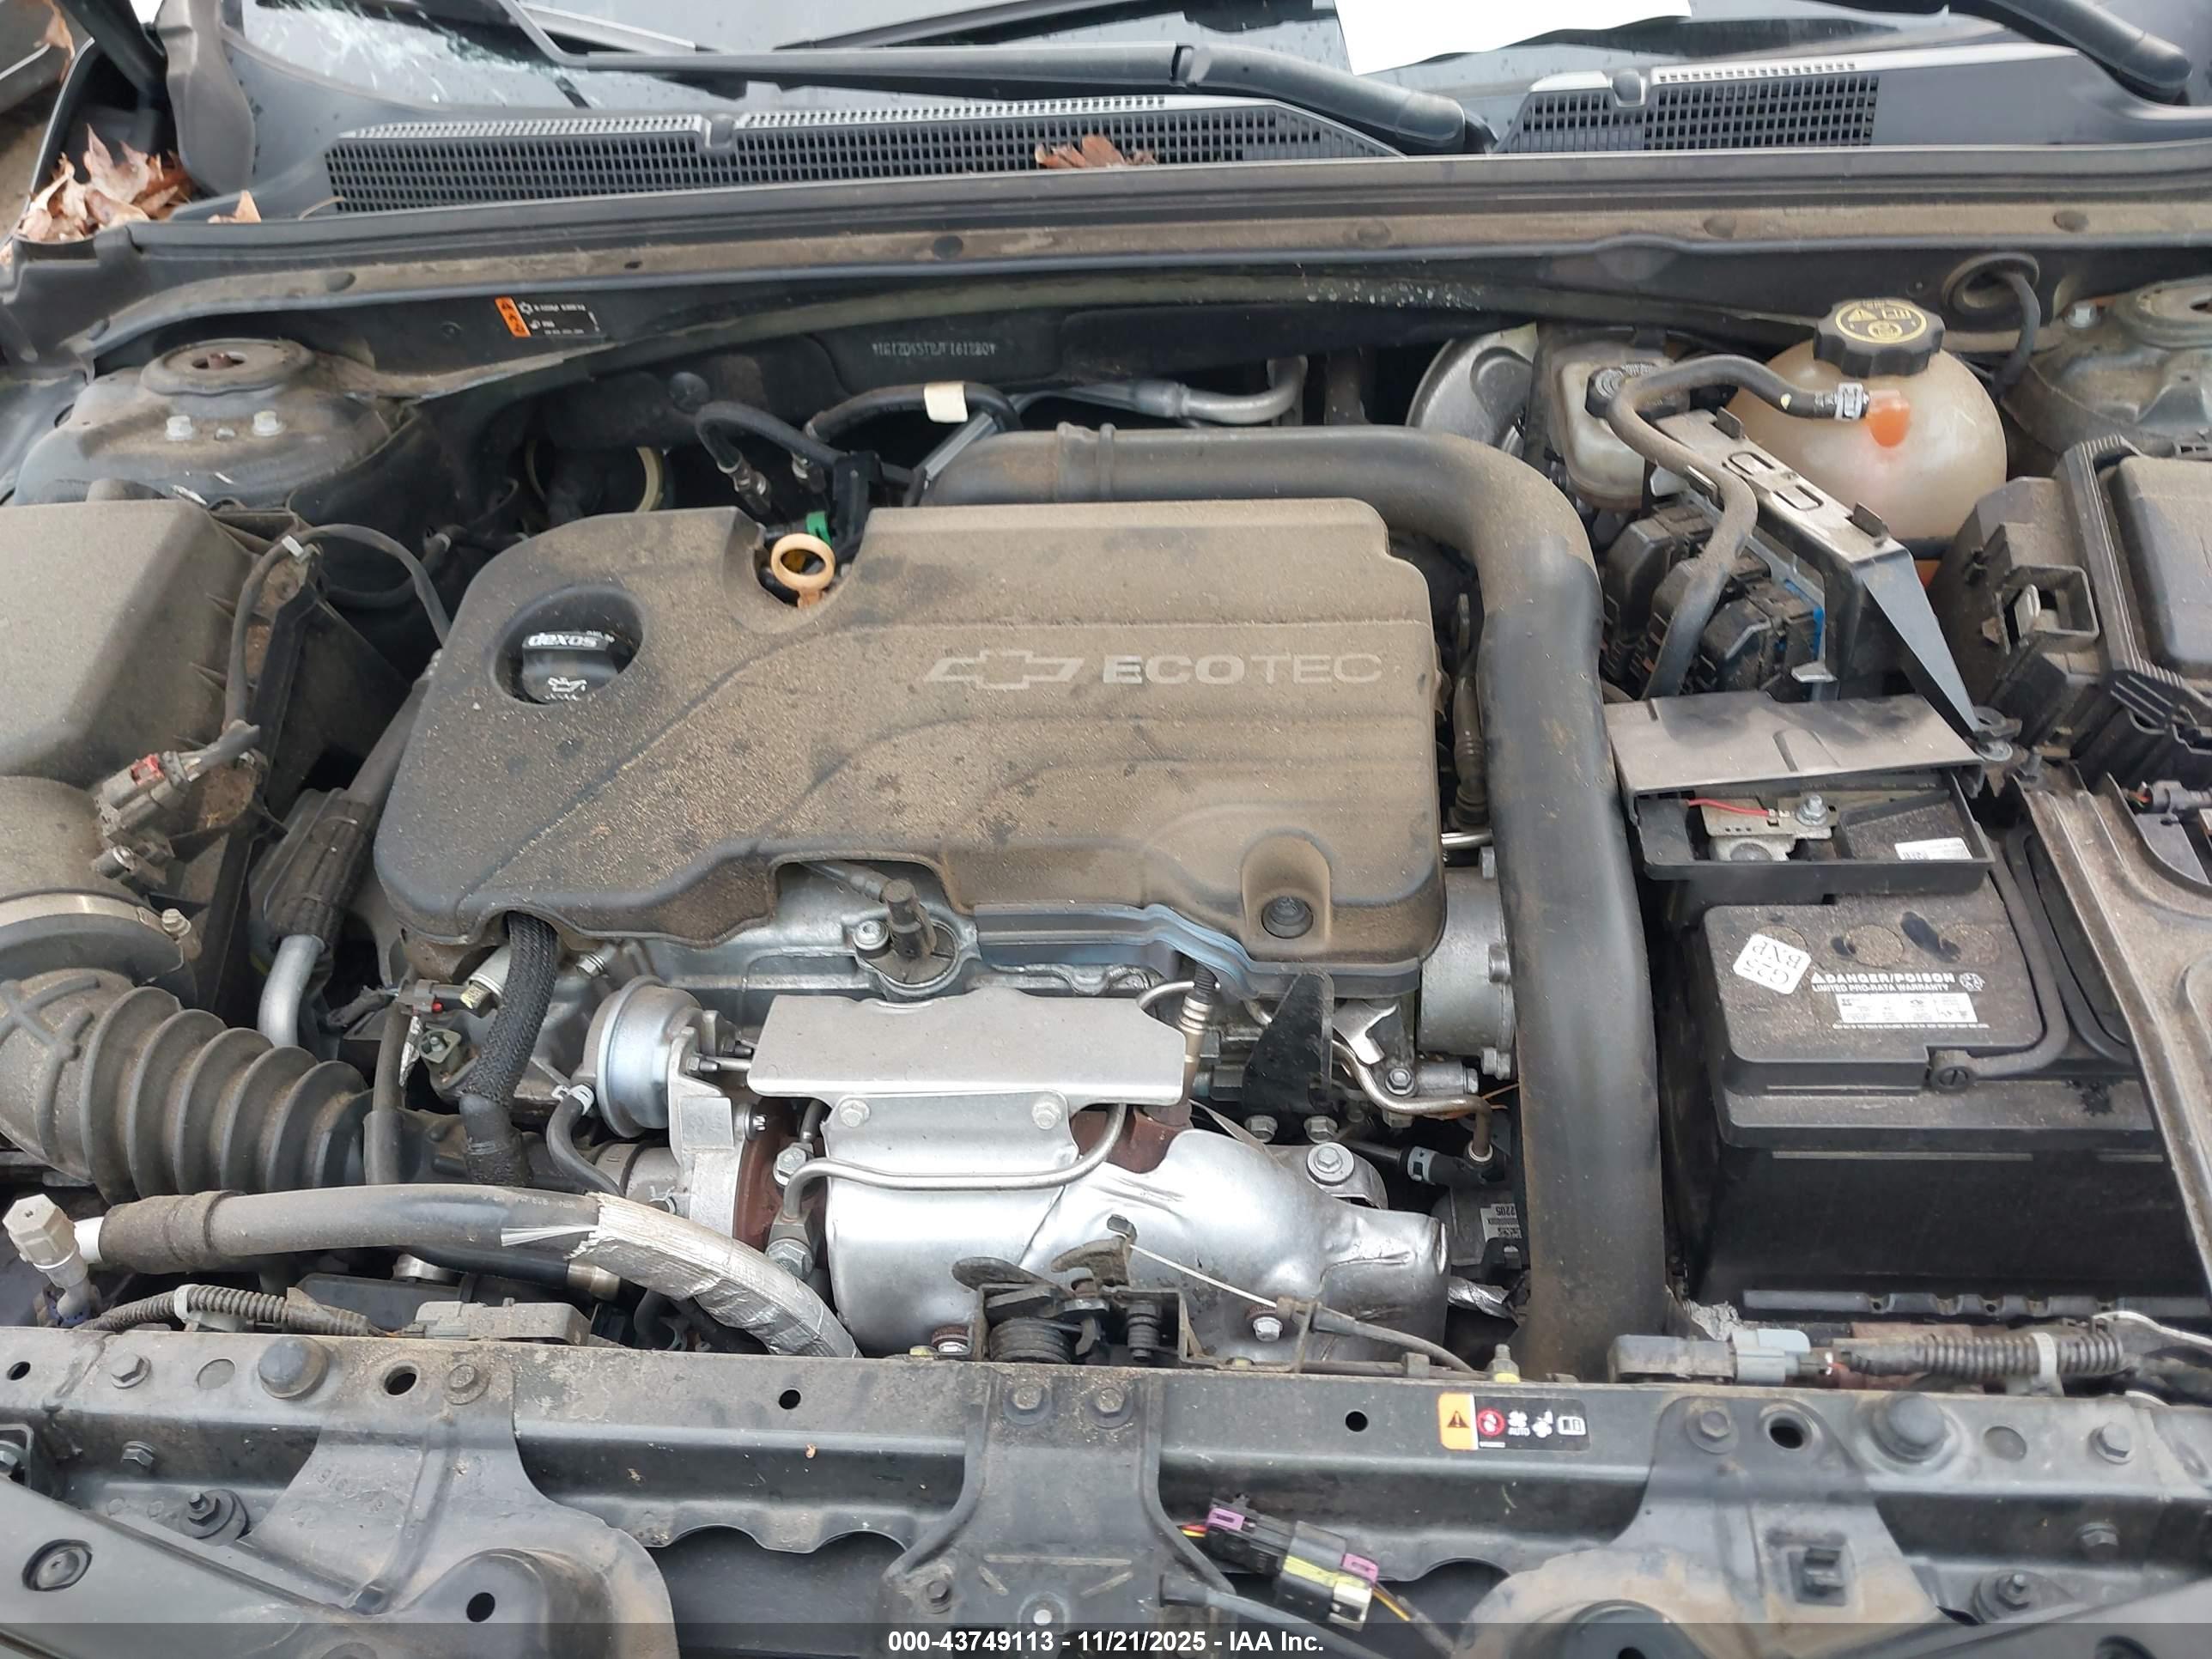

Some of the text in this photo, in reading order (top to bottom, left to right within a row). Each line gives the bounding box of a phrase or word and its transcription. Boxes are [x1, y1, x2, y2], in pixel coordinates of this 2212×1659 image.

[528, 632, 598, 647] dexos
[1103, 653, 1382, 684] ECOTEC
[1826, 972, 1955, 984] DANGER/POISON
[1813, 982, 1948, 993] LIMITED PRO-RATA WARRANTY
